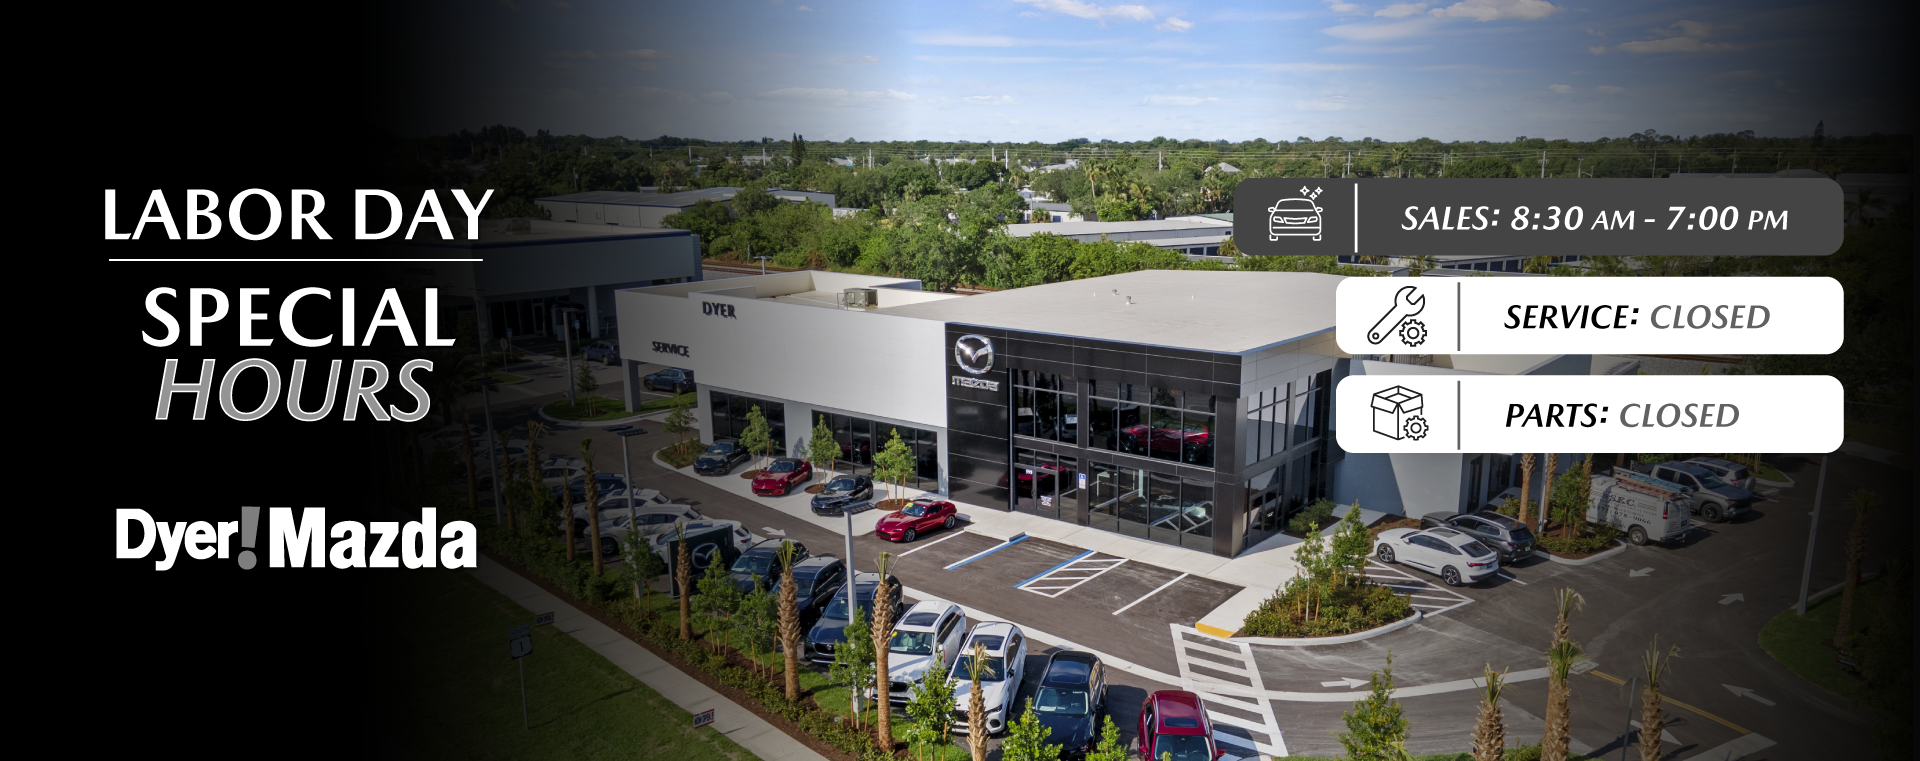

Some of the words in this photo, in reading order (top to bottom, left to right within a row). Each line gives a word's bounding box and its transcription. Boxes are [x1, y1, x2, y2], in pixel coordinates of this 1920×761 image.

[702, 301, 738, 320] DYER
[651, 341, 690, 358] SERVICE
[509, 625, 530, 637] SOUTH
